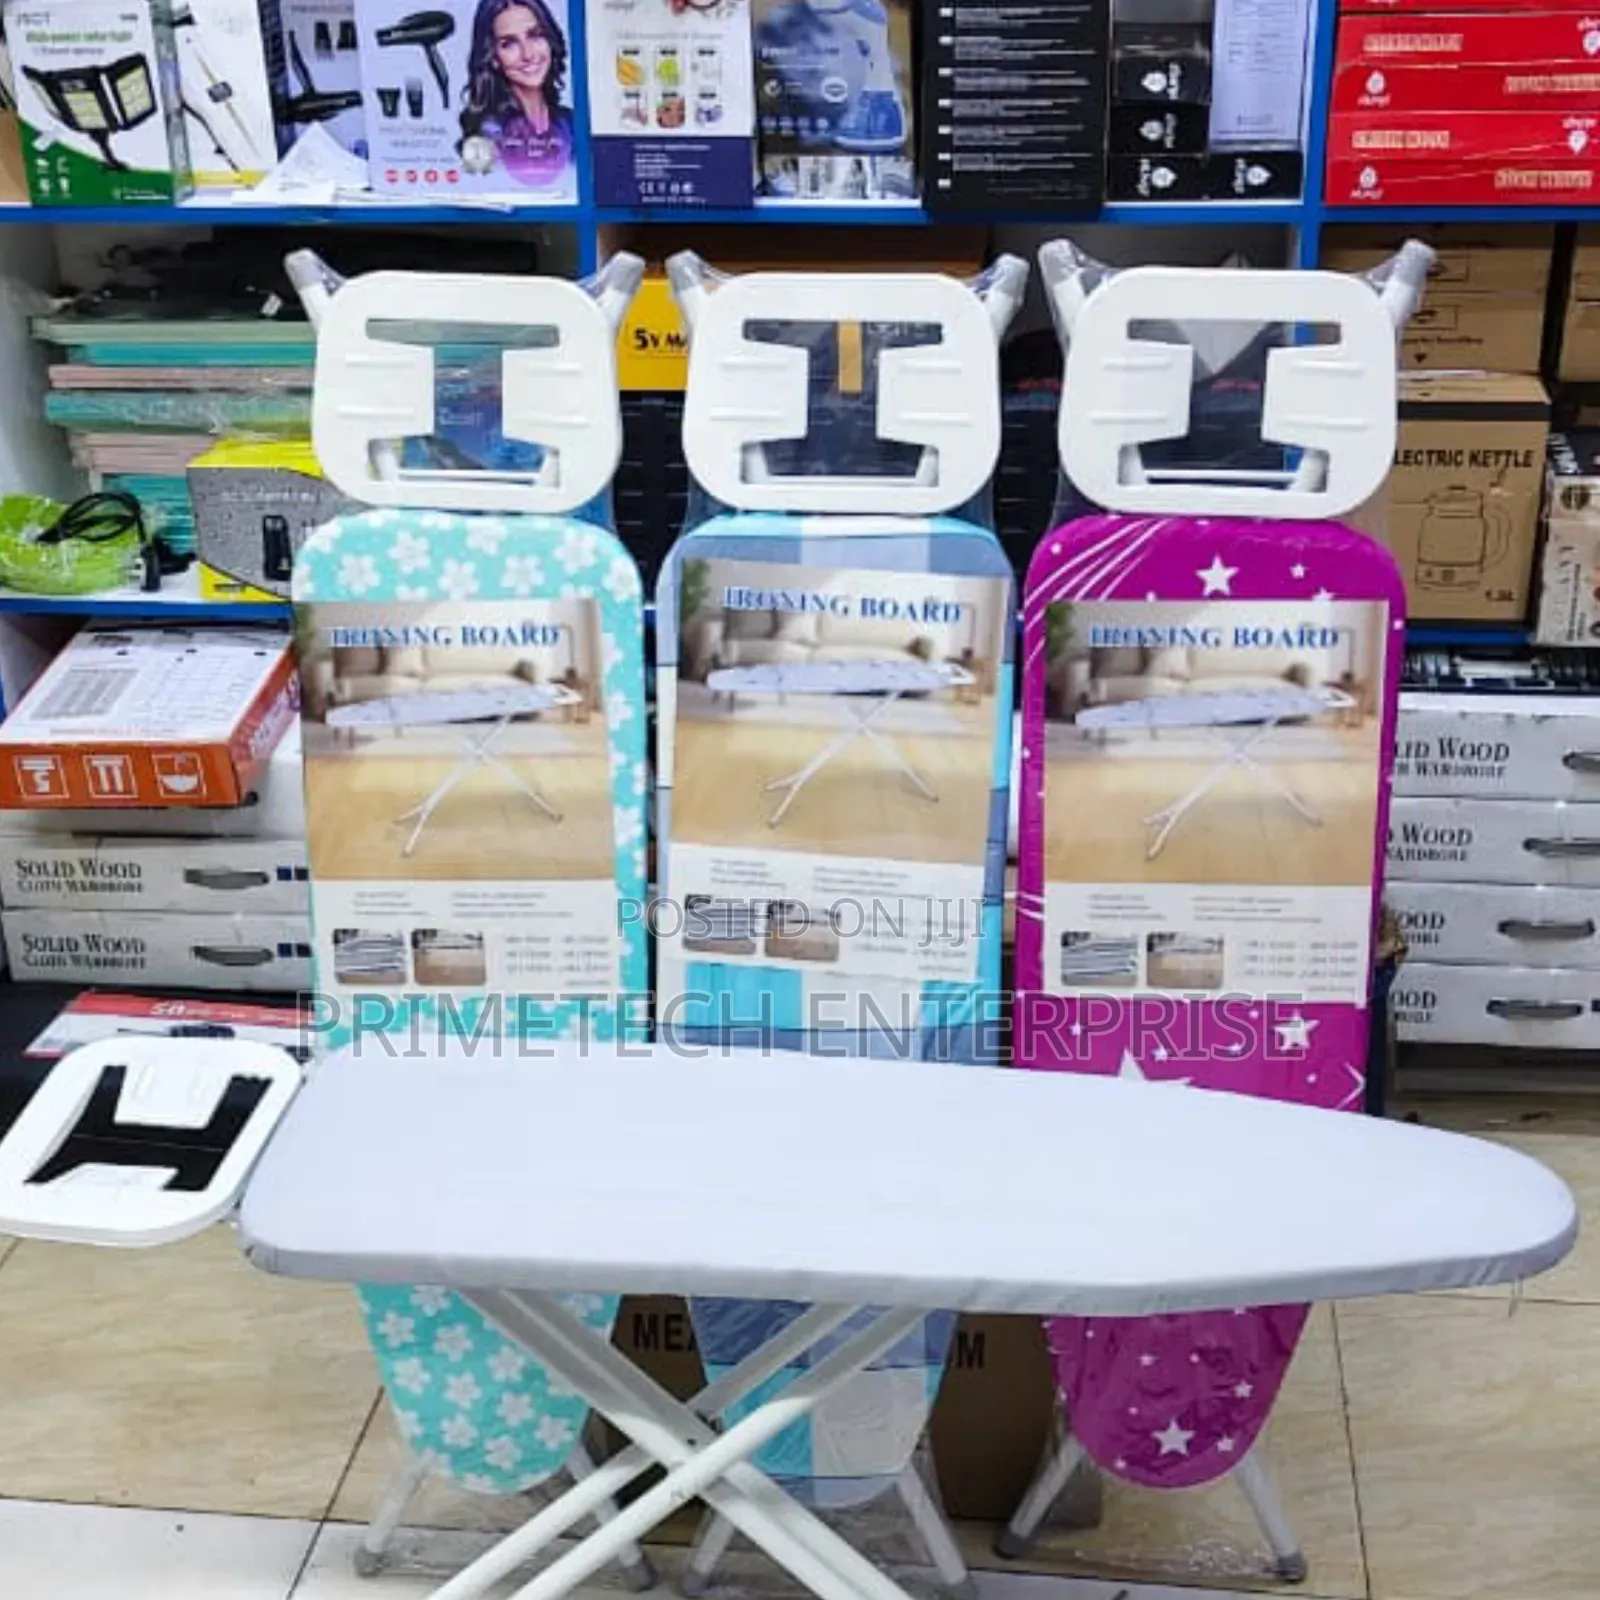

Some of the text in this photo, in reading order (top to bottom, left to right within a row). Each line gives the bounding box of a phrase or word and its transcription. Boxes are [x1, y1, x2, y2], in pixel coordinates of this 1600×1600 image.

[1394, 449, 1534, 468] LECTRIC KETTLE
[724, 586, 962, 624] IRONING BOARD
[331, 624, 560, 647] IRONING BOARD
[1090, 625, 1339, 648] IRONING BOARD
[1394, 742, 1429, 759] LID
[1398, 911, 1445, 930] OOD
[1392, 989, 1437, 1009] OOD
[633, 1313, 693, 1352] ME
